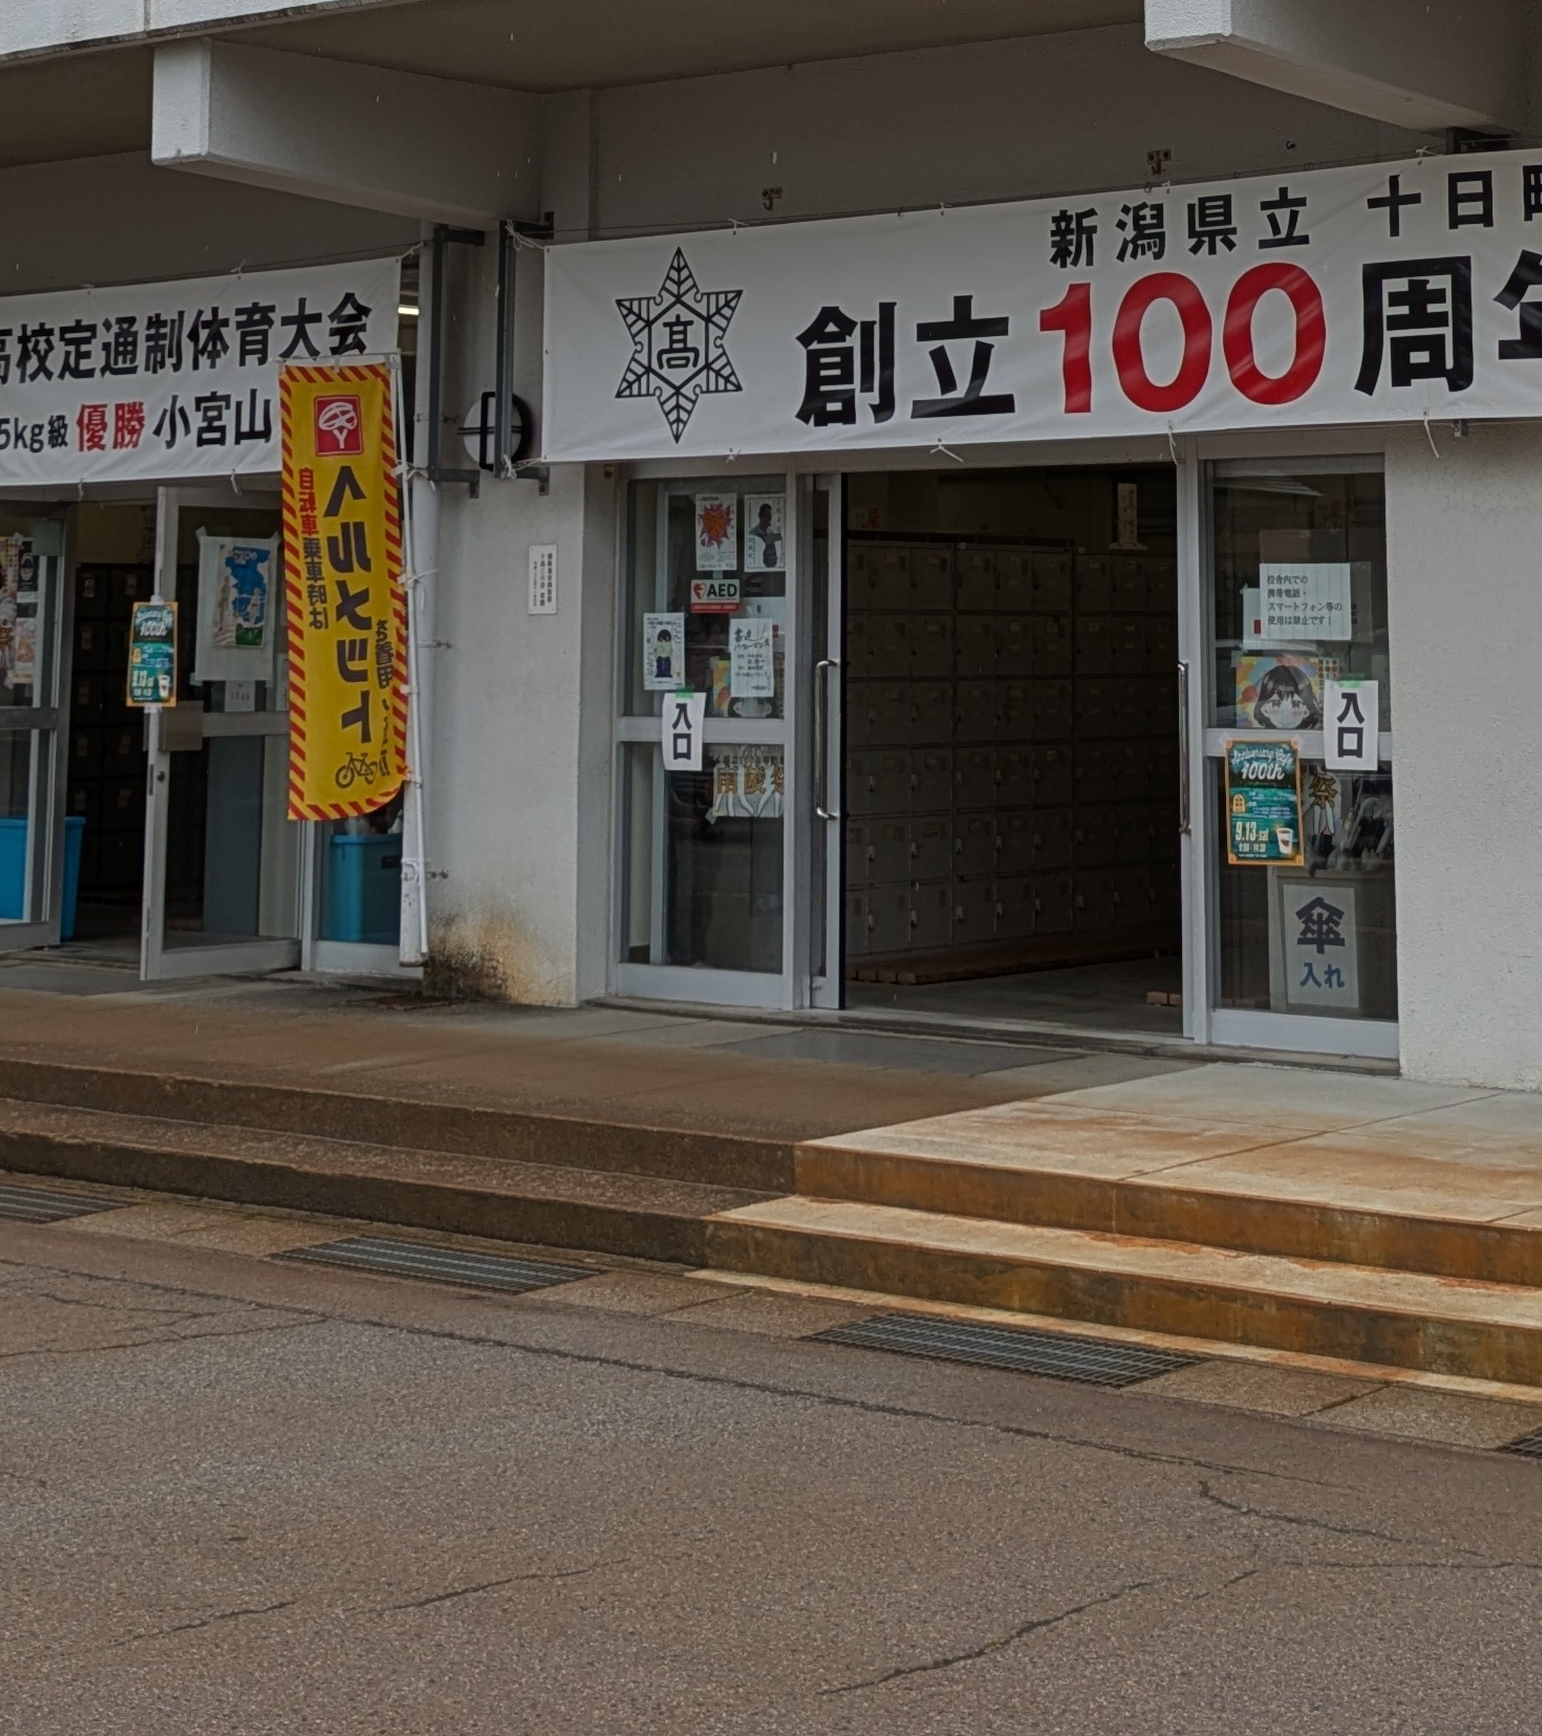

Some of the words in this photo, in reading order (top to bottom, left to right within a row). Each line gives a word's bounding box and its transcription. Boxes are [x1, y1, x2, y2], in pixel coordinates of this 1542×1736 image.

[1050, 186, 1310, 267] 新潟県立
[75, 401, 146, 453] 優勝
[152, 388, 273, 450] 小宮山
[707, 583, 737, 597] AED
[672, 703, 692, 761] 入口
[1337, 692, 1365, 758] 入口
[1242, 763, 1285, 780] 100th
[1296, 896, 1345, 954] 傘
[1300, 962, 1345, 988] 入れ
